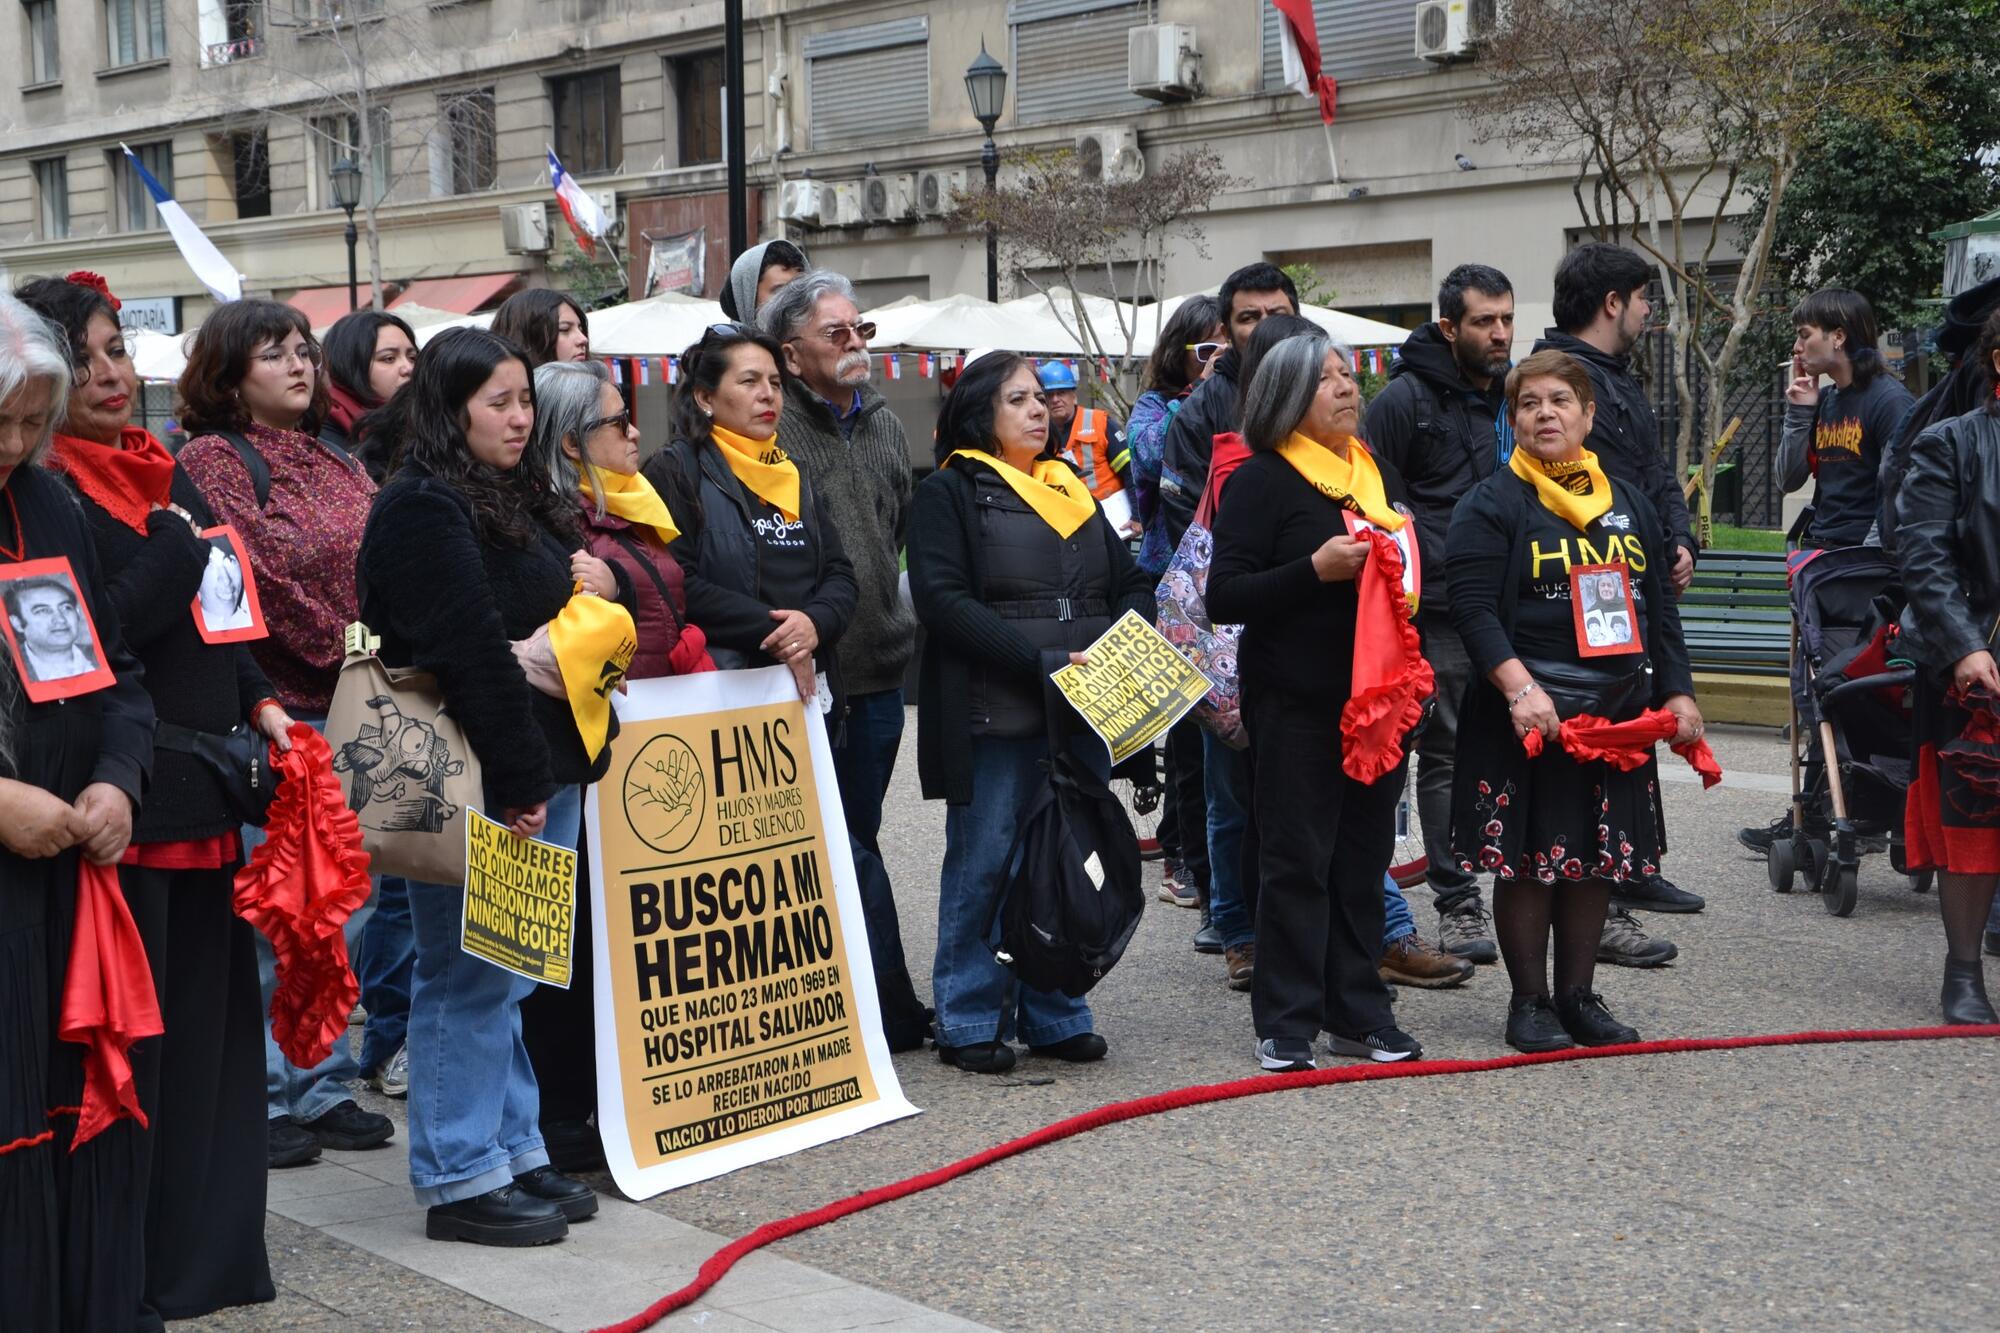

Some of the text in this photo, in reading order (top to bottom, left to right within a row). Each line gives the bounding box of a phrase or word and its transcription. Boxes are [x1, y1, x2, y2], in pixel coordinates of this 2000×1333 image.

[766, 538, 805, 546] LONDON
[1531, 534, 1647, 579] HMS
[1060, 616, 1144, 693] LAS MUJERES
[1069, 691, 1091, 709] NO
[1085, 630, 1159, 696] OLVIDAMOS
[1084, 703, 1106, 725] NI
[1100, 645, 1176, 716] PERDONAMOS
[1141, 662, 1193, 708] GOLPE
[711, 717, 798, 798] HMS
[717, 787, 803, 821] HIJOS Y MADRES
[718, 808, 806, 847] DEL SILENCIO
[470, 815, 573, 878] LAS MUJERES
[470, 841, 570, 903] NO OLVIDAMOS
[469, 868, 570, 931] NI PERDONAMOS
[629, 850, 824, 938] BUSCO A MI
[518, 920, 568, 957] GOLPE
[634, 904, 834, 1002] HERMANO
[640, 964, 841, 1032] QUE NACIO 23 MAYO 1969 EN
[643, 990, 847, 1069] HOSPITAL SALVADOR
[652, 1035, 852, 1106] SE LO ARREBATARON A MI MADRE
[712, 1069, 812, 1114] RECIEN NACIDO
[660, 1081, 862, 1152] NACIO Y LO DIERON POR MUERTO.
